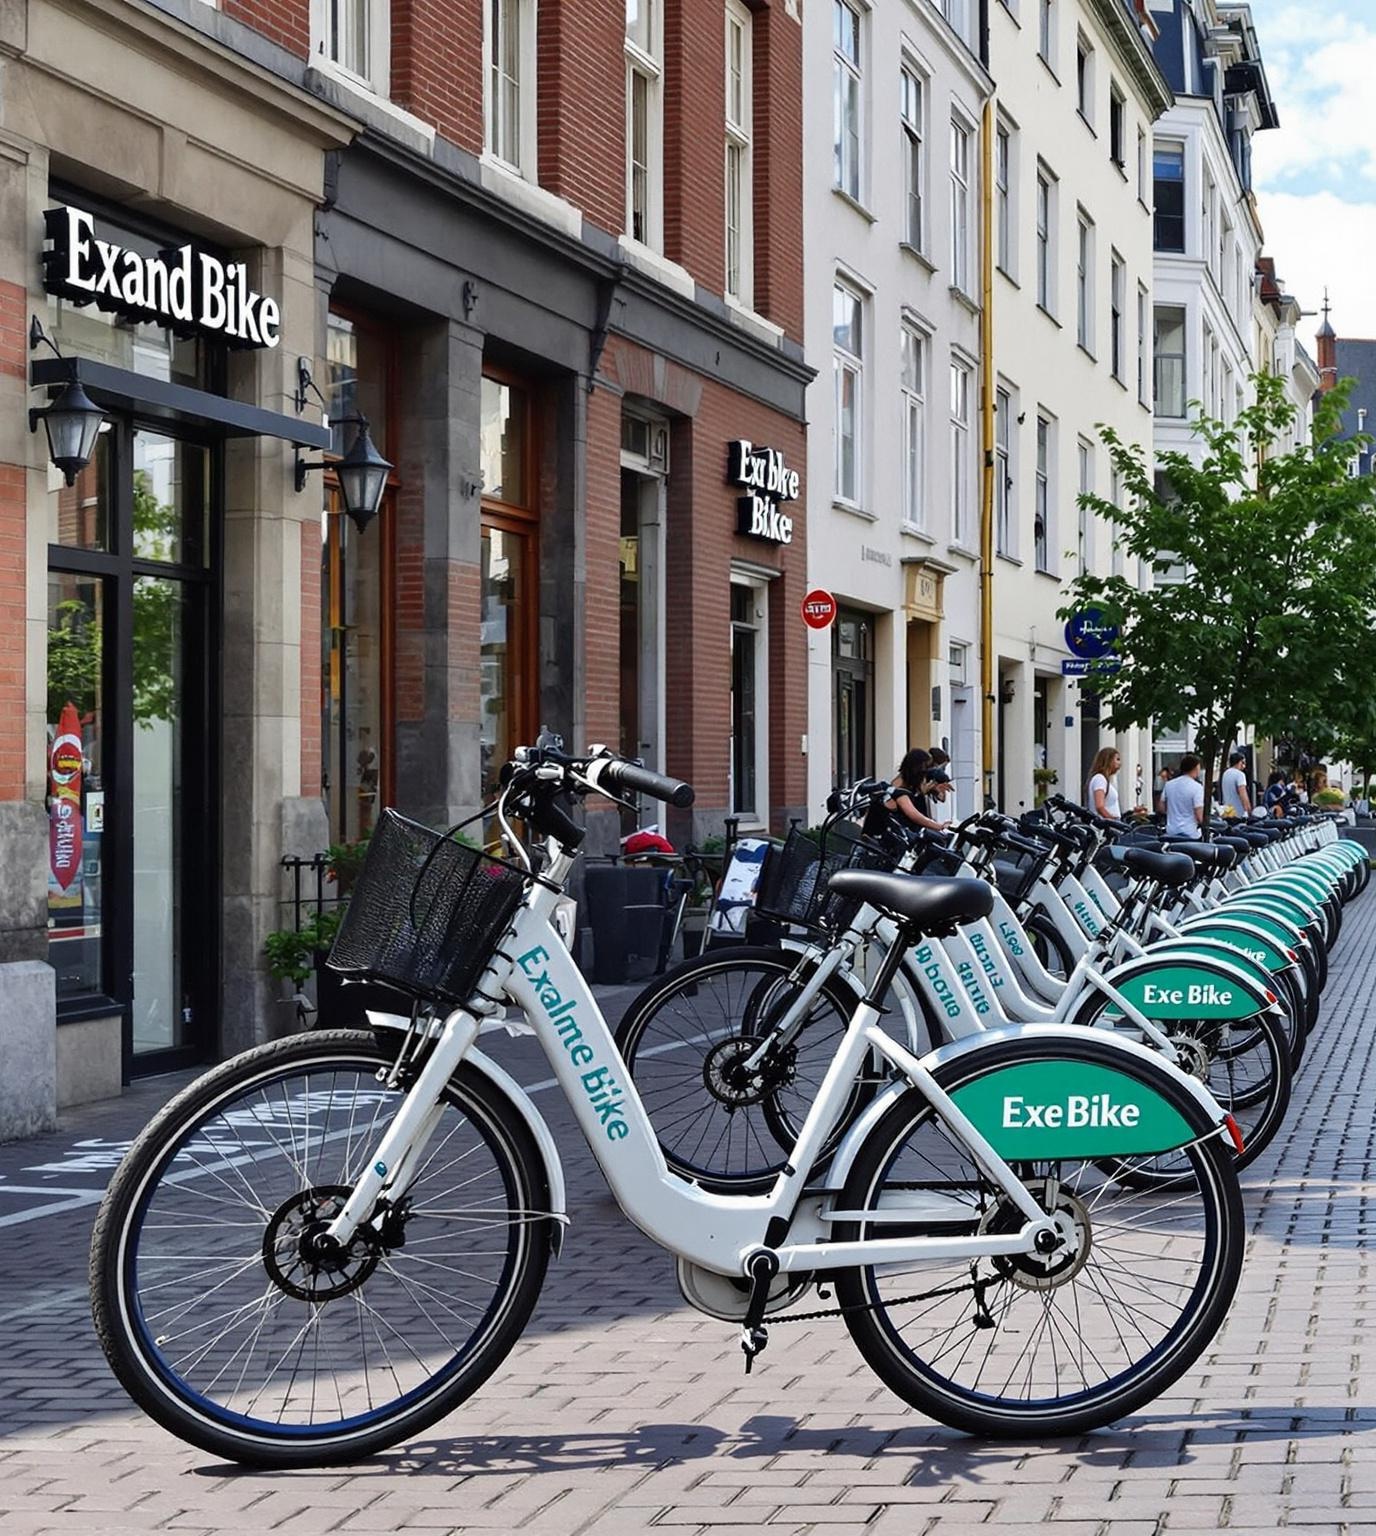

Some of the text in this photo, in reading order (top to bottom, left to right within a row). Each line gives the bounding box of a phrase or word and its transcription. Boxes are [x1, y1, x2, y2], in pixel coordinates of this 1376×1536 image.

[65, 206, 280, 348] Exand Bike
[1143, 984, 1232, 1005] Exe Bike
